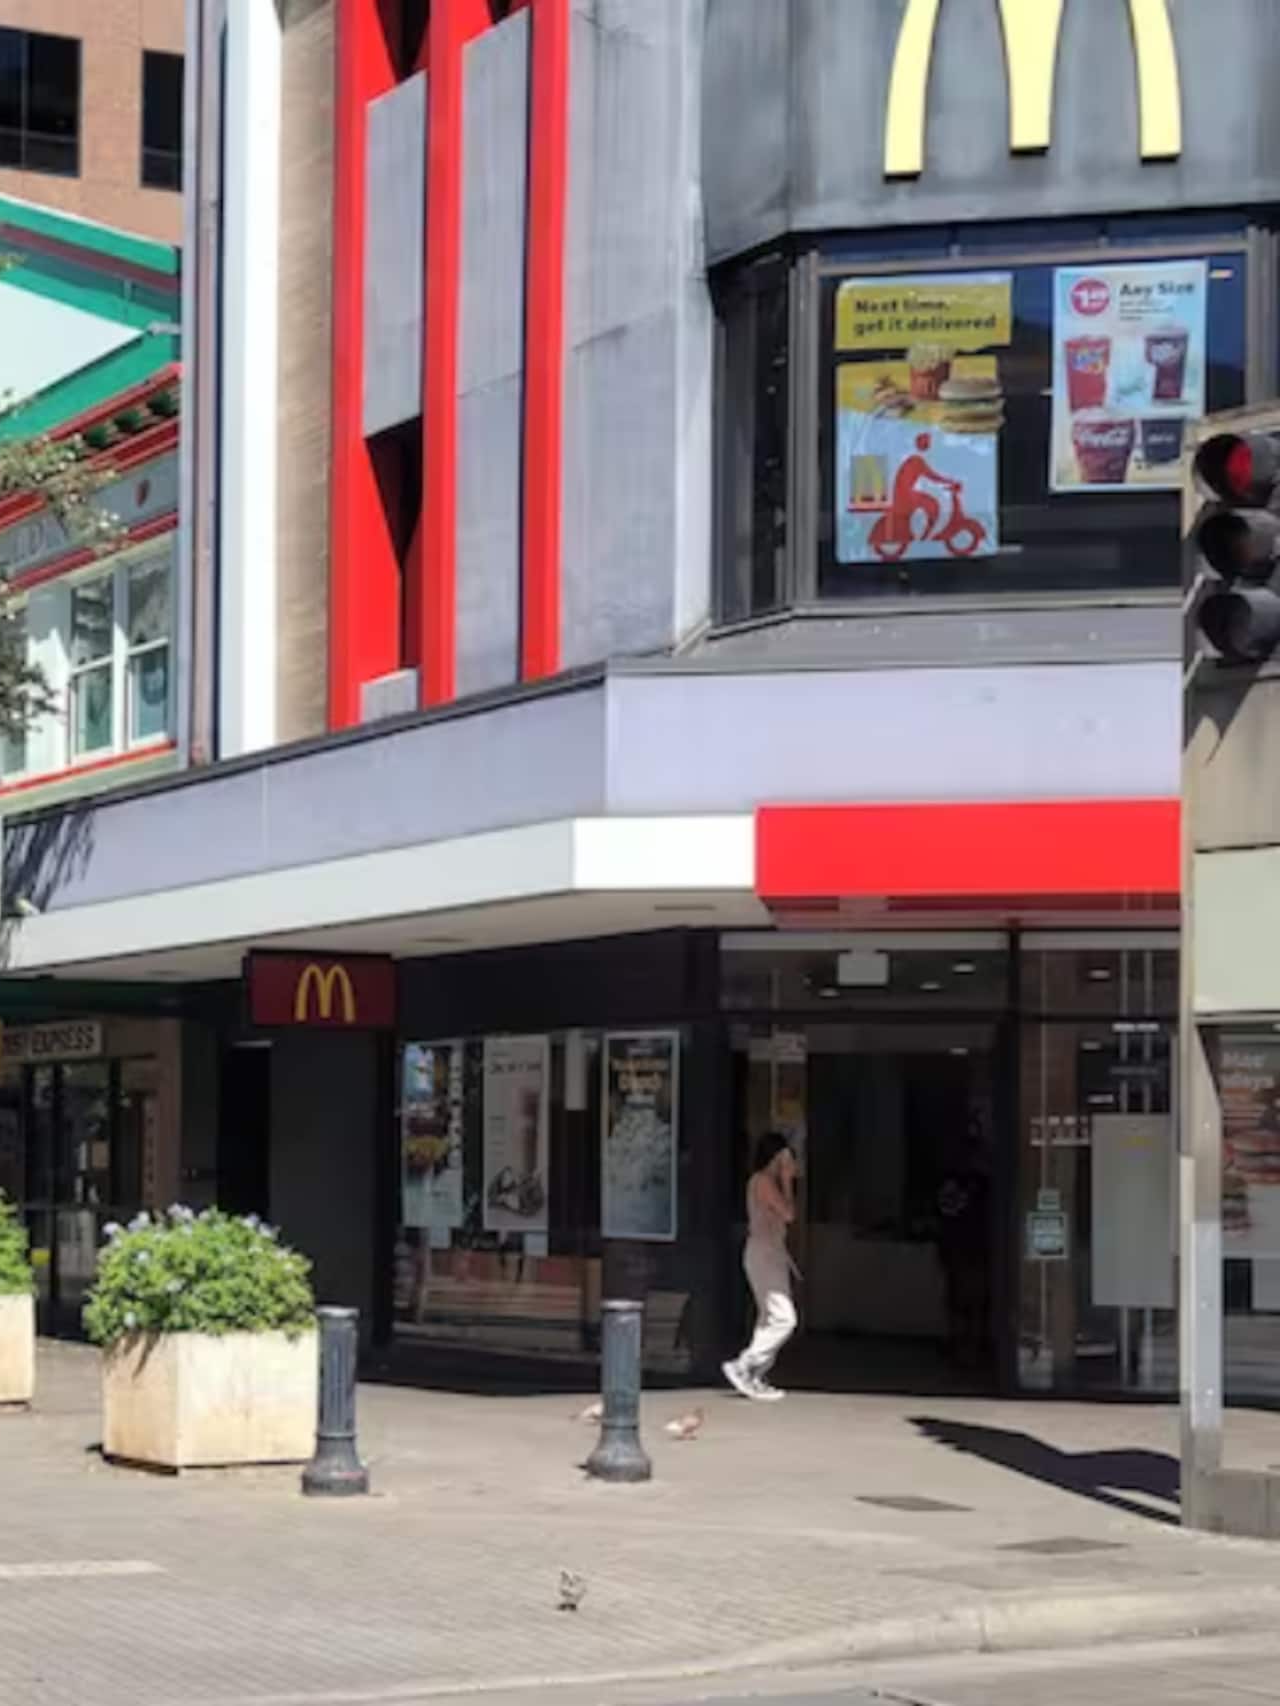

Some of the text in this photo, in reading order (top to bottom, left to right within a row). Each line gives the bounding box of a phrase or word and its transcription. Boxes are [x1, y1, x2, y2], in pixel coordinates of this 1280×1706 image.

[1120, 283, 1152, 299] Any
[1158, 281, 1194, 294] Size
[855, 300, 897, 313] Next
[854, 312, 996, 336] get it delivered
